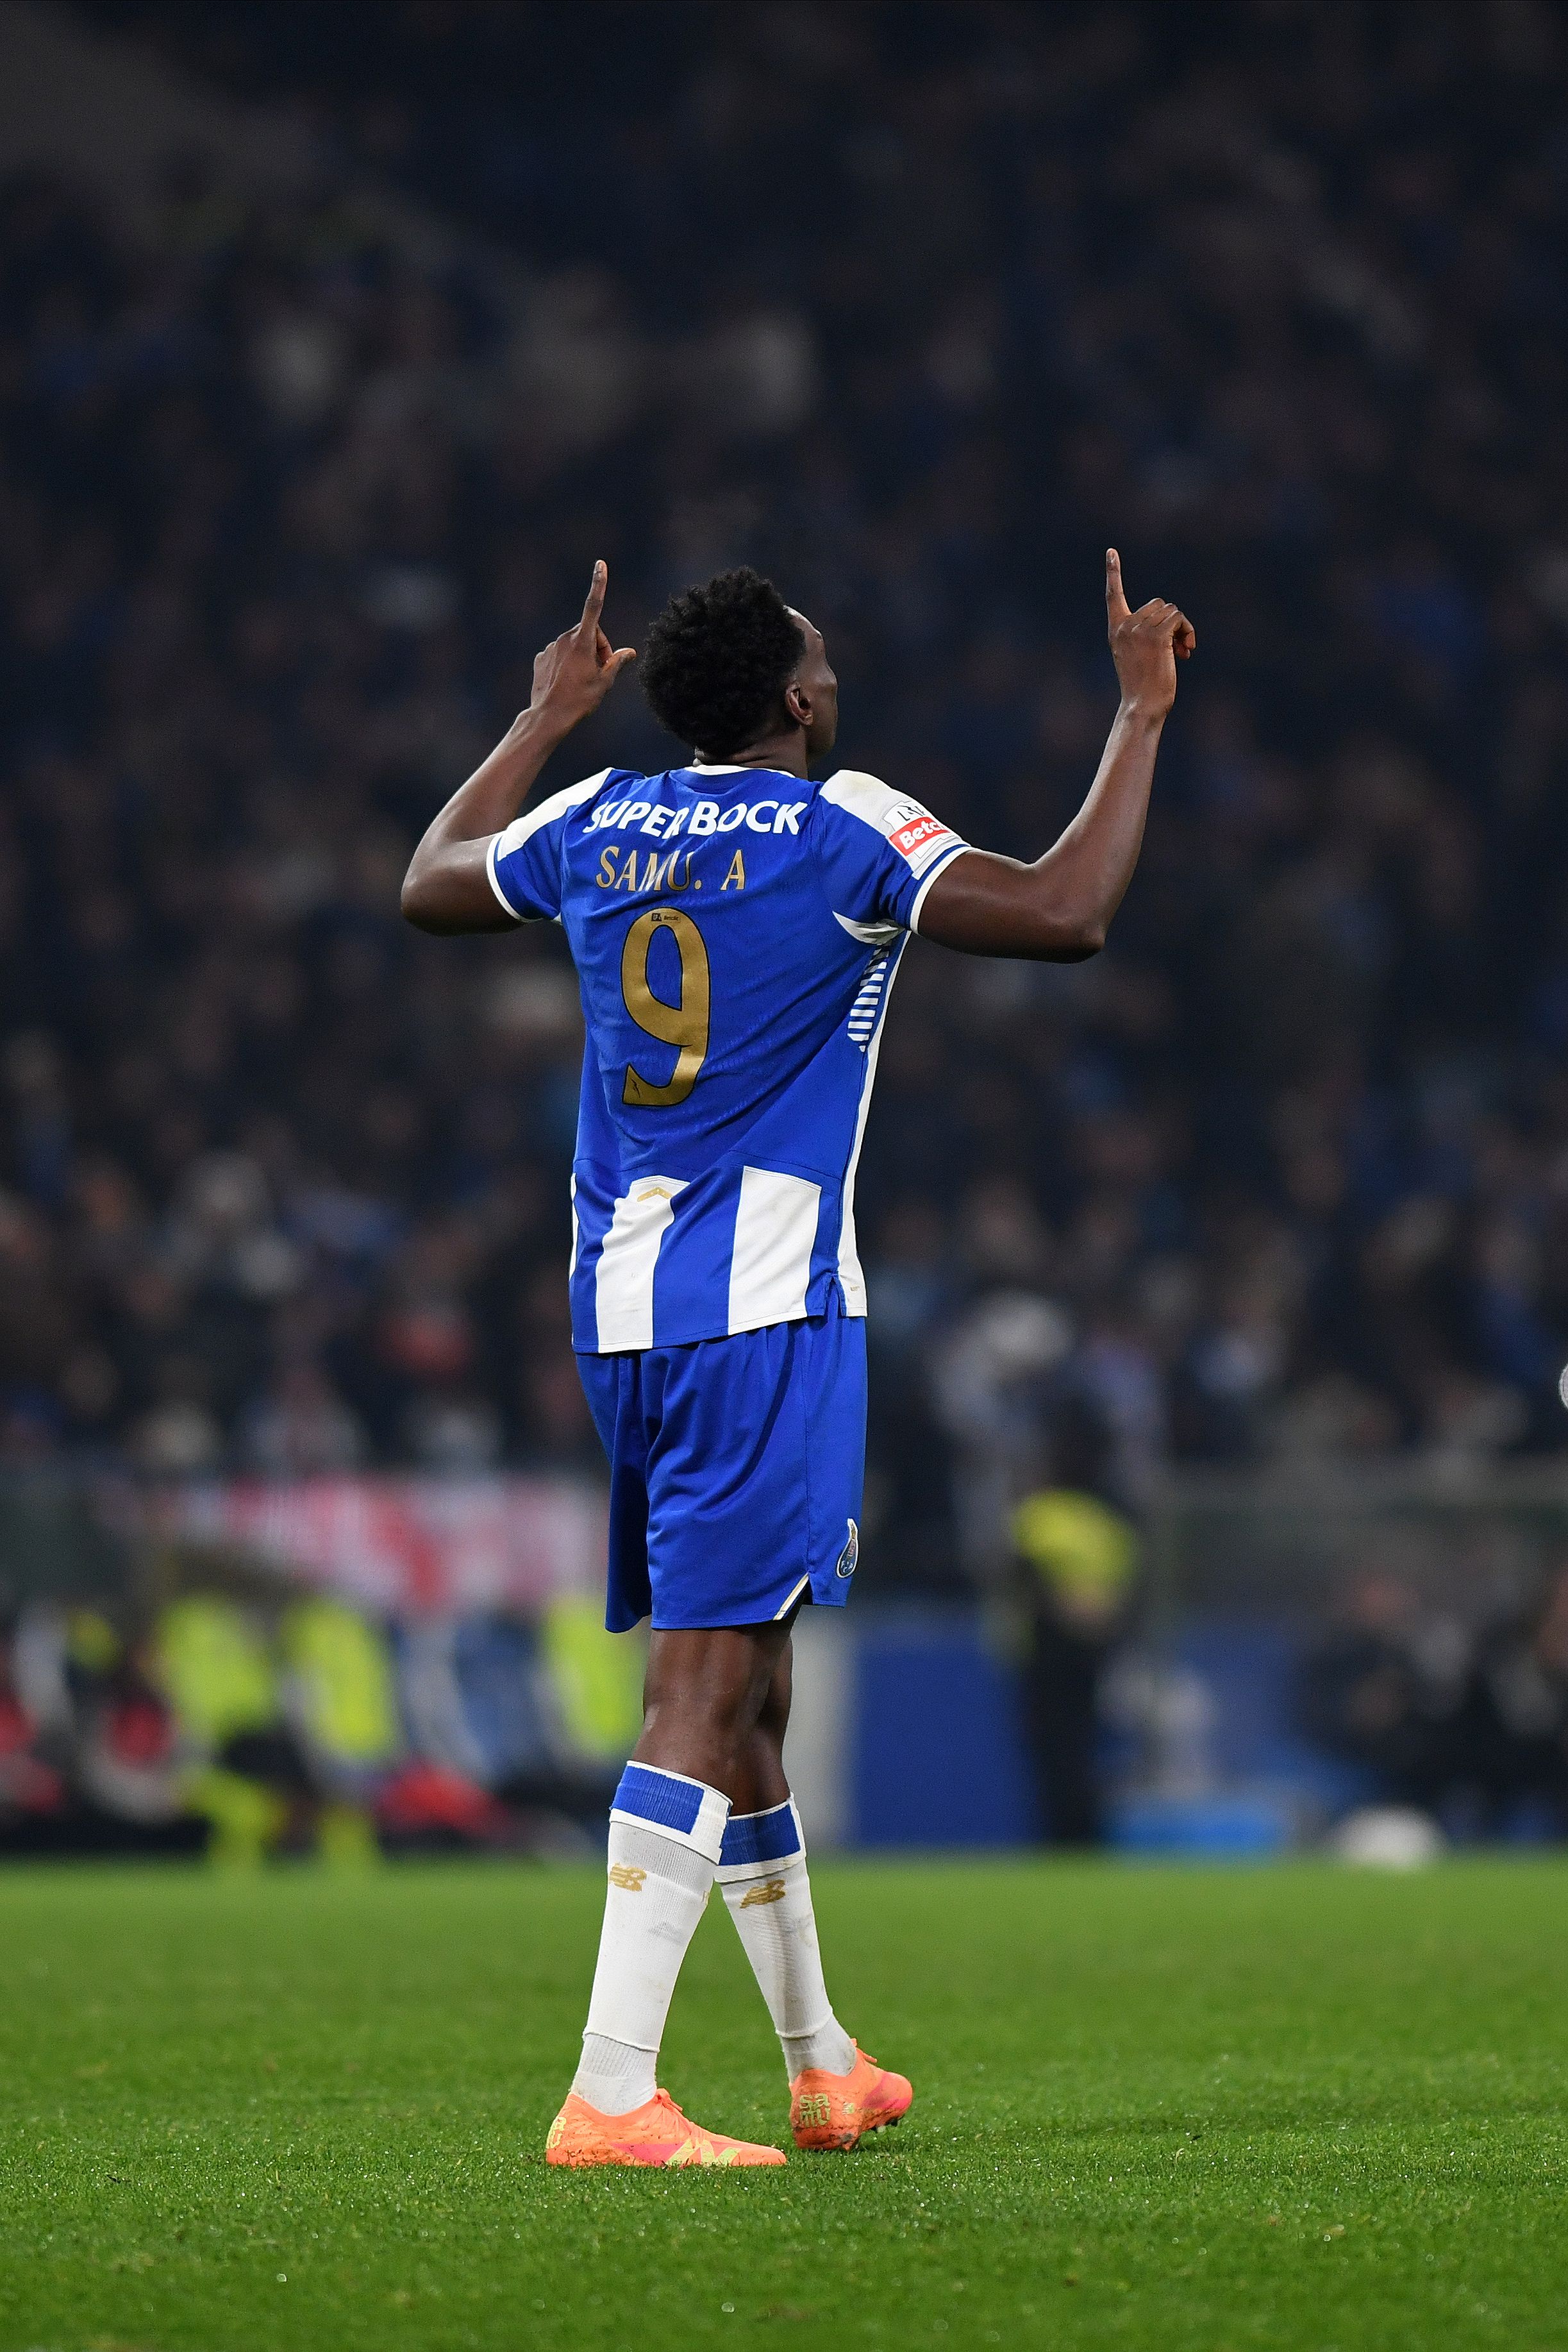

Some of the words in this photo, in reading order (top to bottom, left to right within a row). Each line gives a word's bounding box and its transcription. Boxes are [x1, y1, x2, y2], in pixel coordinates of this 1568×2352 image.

[688, 800, 808, 836] BOCK
[898, 820, 945, 850] Betc
[719, 848, 746, 891] A
[621, 907, 711, 1107] 9
